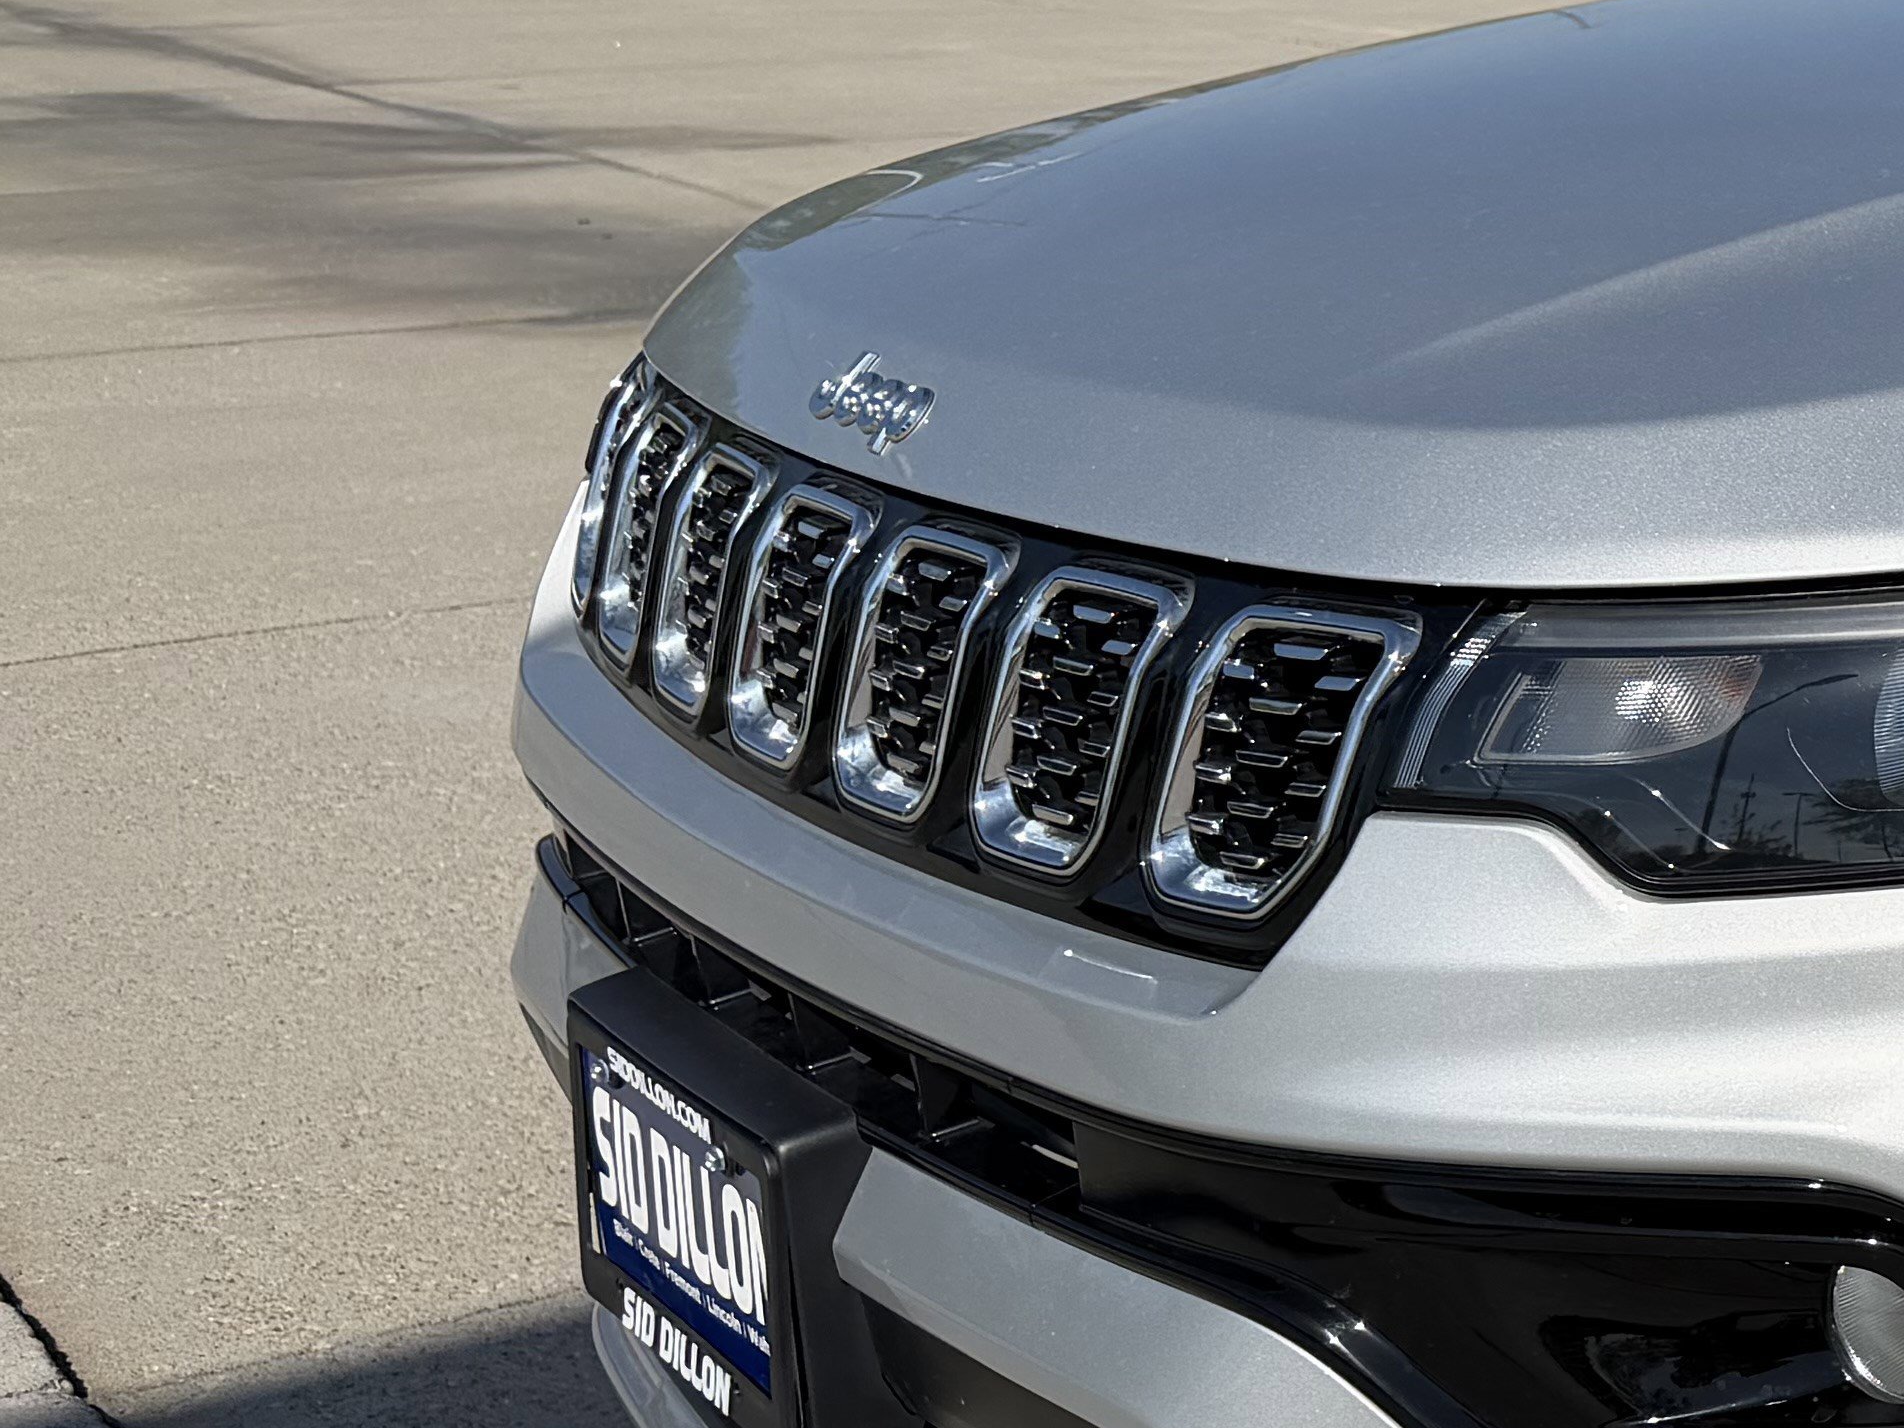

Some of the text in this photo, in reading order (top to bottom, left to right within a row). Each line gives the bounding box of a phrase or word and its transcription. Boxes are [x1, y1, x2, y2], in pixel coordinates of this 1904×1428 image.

[809, 351, 936, 456] Jeep
[606, 1046, 711, 1144] SIDDILLON.COM
[593, 1086, 768, 1326] SID DILLON
[621, 1286, 732, 1417] SID DILLON
